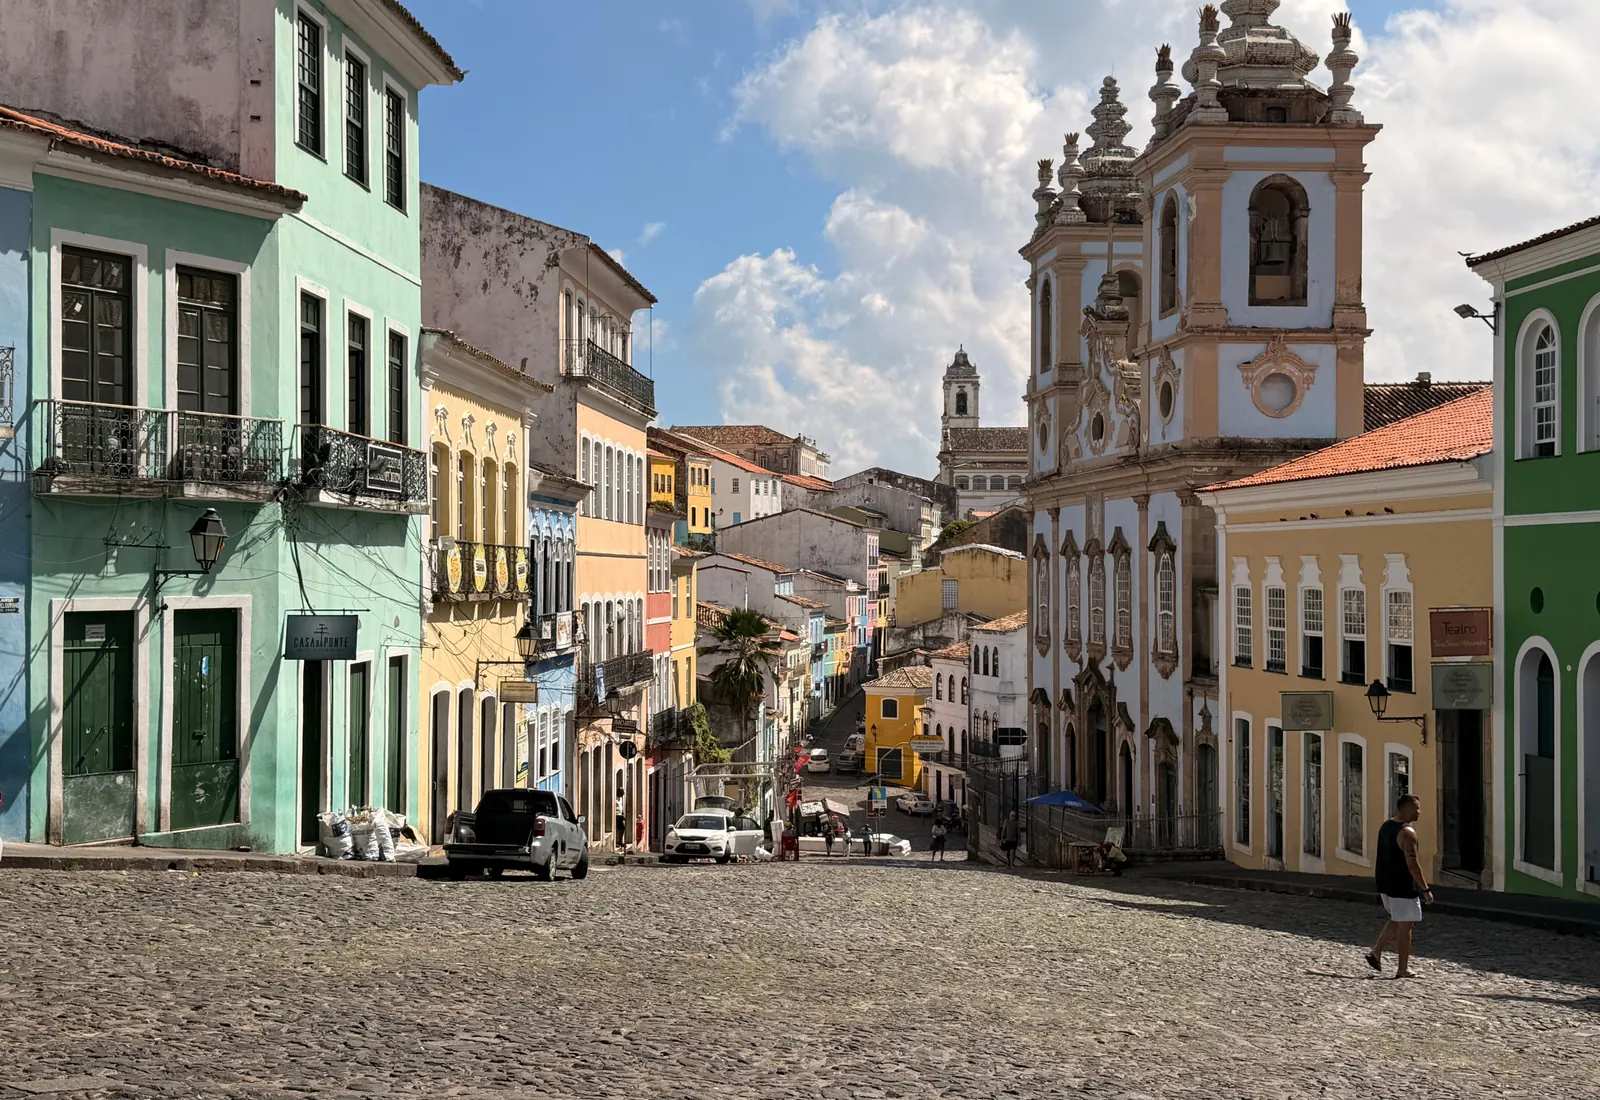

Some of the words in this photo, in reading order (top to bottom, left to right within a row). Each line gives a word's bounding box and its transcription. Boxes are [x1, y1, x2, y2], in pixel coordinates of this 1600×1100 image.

[1442, 621, 1477, 636] Teatro
[293, 637, 315, 648] CASA
[324, 637, 349, 648] PONTE
